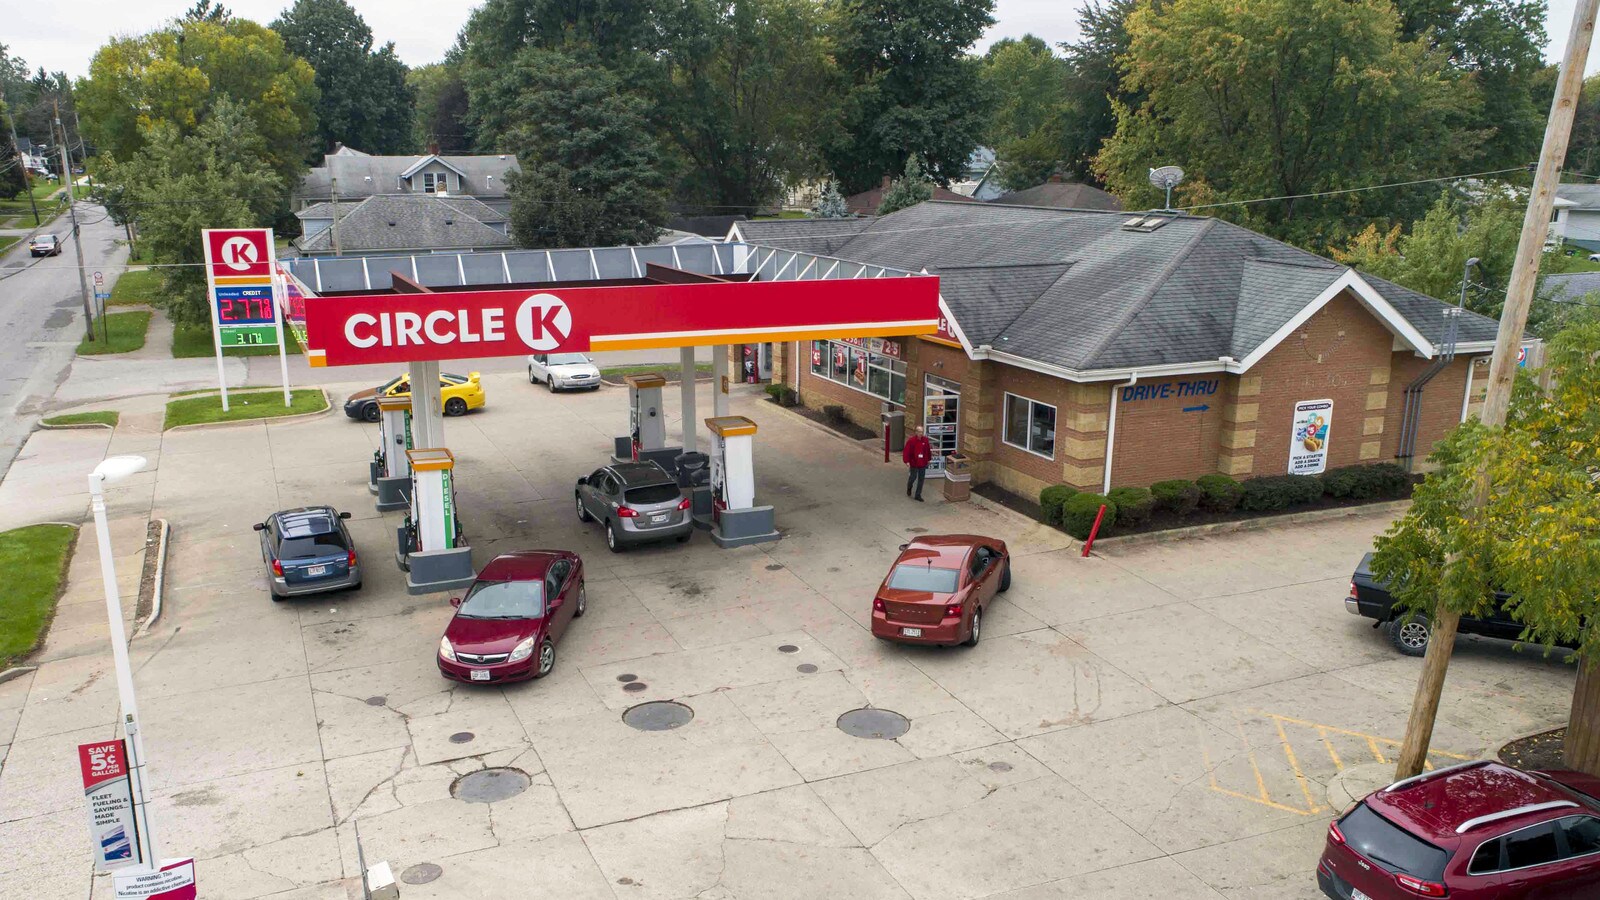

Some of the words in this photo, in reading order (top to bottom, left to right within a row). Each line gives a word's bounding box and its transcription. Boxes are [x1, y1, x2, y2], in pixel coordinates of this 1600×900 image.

[344, 308, 505, 348] CIRCLE
[1122, 380, 1219, 402] DRIVE-THRU
[404, 413, 412, 449] DIESEL
[442, 473, 450, 516] DIESEL
[88, 745, 115, 755] SAVE
[91, 753, 116, 771] 5¢
[91, 768, 120, 777] GALLON
[93, 799, 121, 807] FUELING
[95, 812, 114, 820] MADE
[96, 818, 120, 826] SIMPLE
[145, 880, 164, 888] contains
[150, 885, 170, 894] addictive
